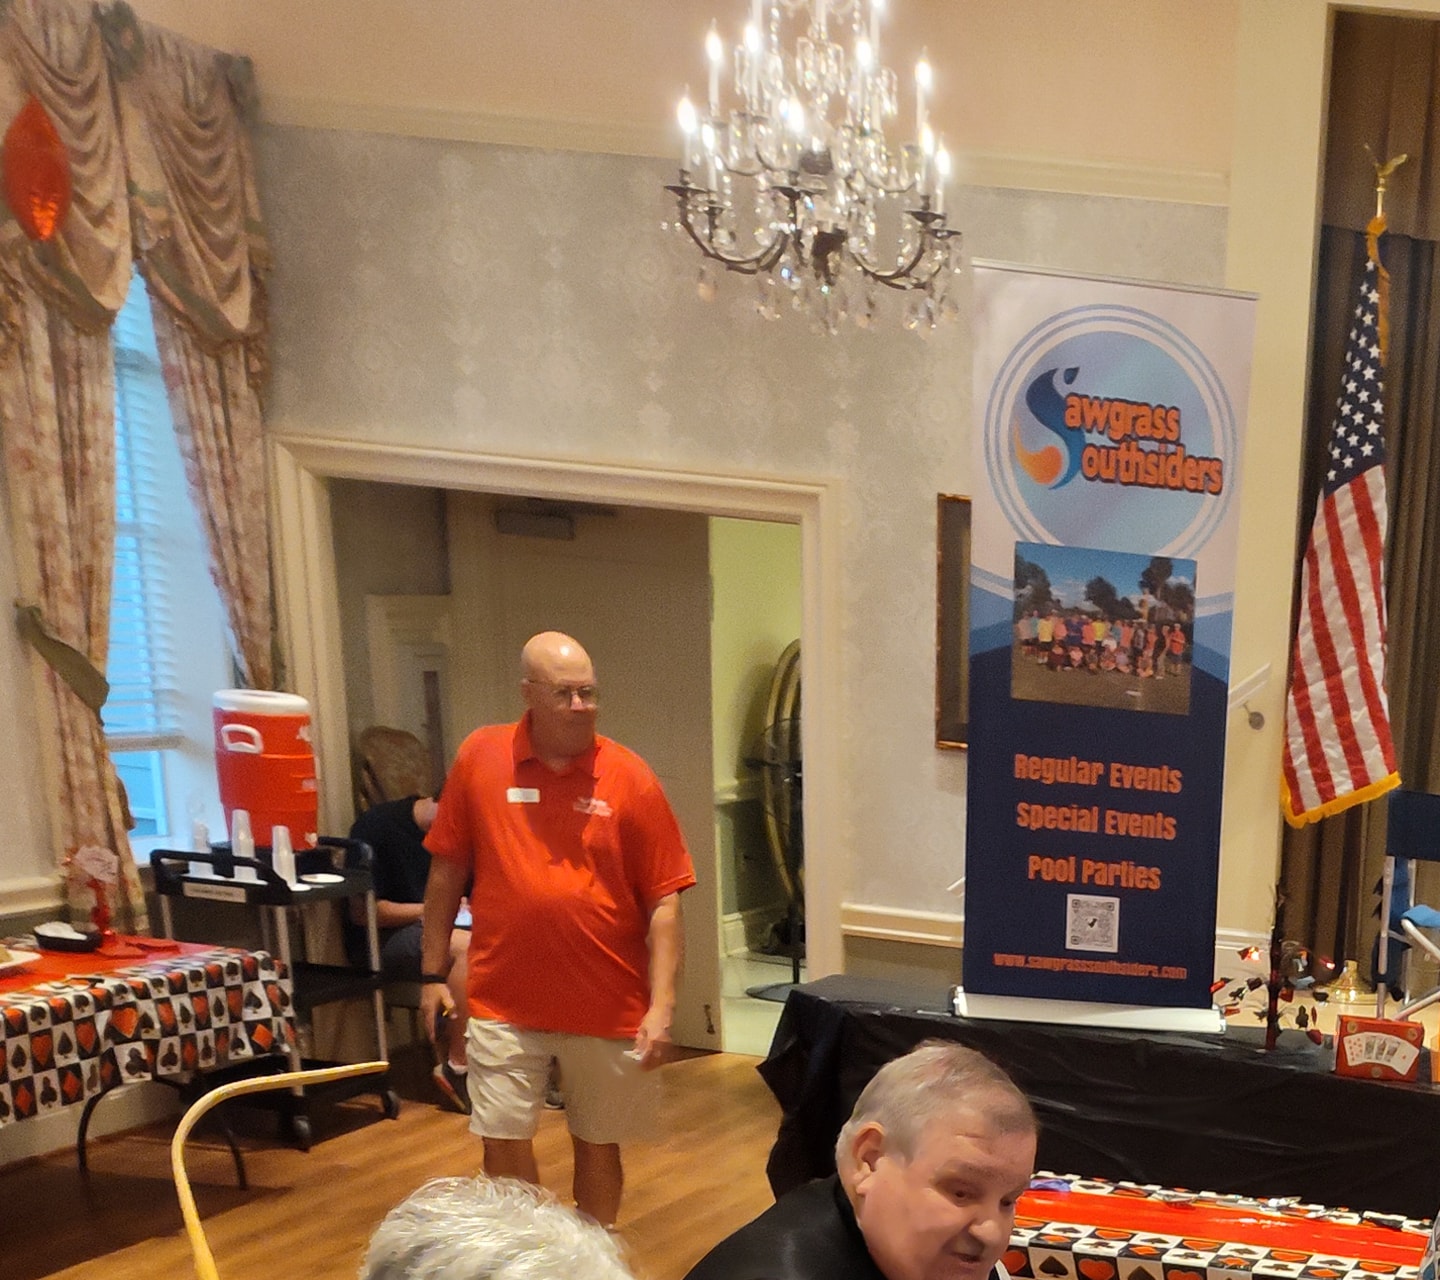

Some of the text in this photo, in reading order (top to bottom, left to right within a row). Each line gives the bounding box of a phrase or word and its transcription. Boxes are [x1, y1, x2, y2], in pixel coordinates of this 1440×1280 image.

[1013, 753, 1183, 794] Regular Events
[1016, 802, 1177, 840] Special Events
[1028, 855, 1162, 890] Pool Parties
